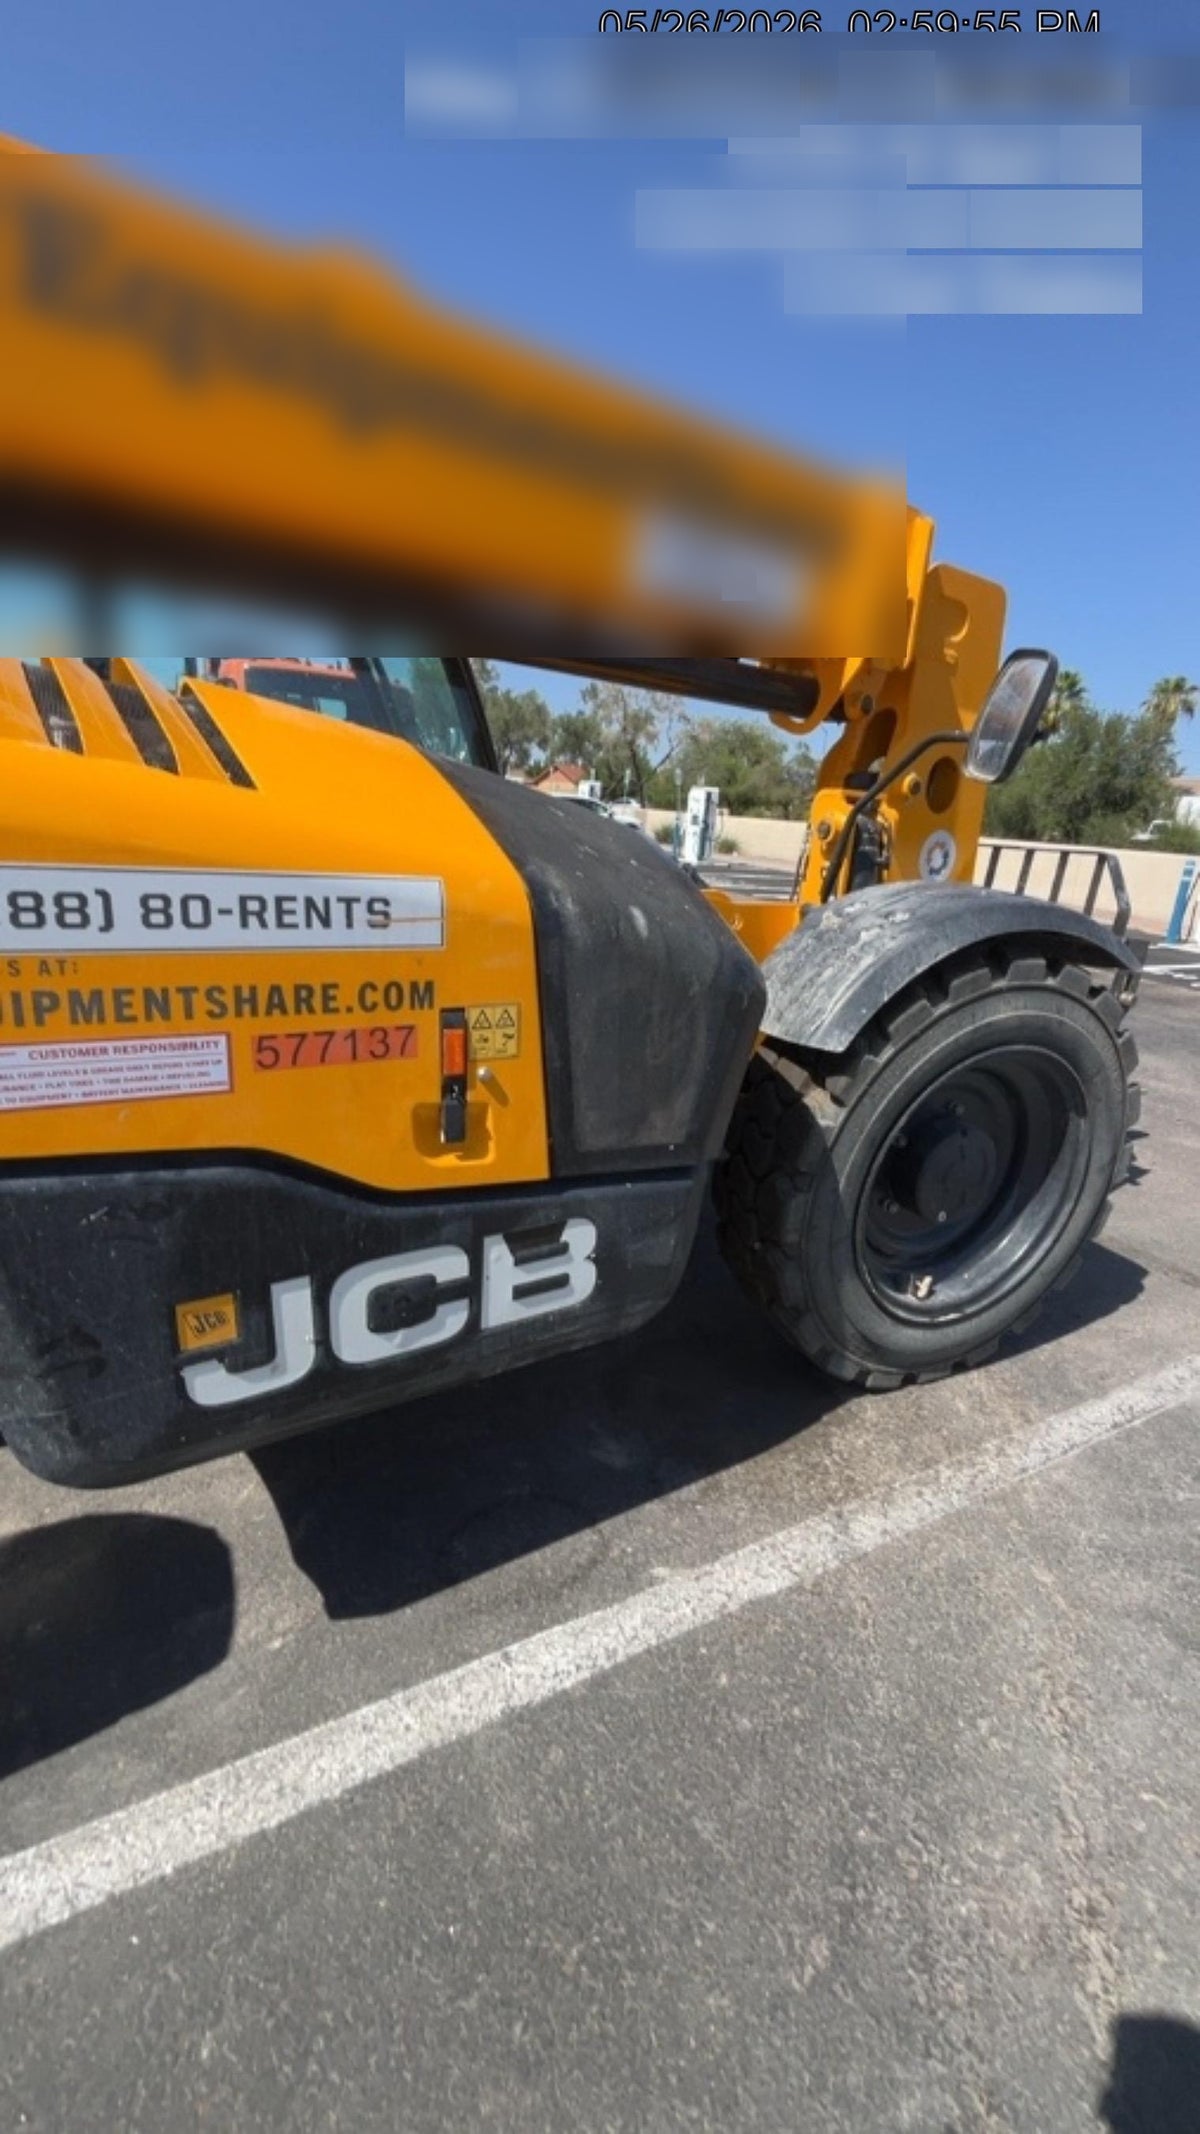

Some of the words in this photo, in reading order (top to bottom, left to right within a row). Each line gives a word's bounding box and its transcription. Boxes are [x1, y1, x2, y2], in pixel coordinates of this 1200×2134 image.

[0, 888, 115, 932] 88)
[139, 892, 392, 931] 80-RENTS
[38, 959, 79, 977] AT:
[0, 980, 435, 1028] IPMENTSHARE.COM
[28, 1045, 109, 1060] CUSTOMER
[113, 1041, 220, 1055] RESPONSIBILITY
[256, 1024, 415, 1070] 577137
[181, 1217, 597, 1407] JCB
[192, 1309, 227, 1334] JCB
